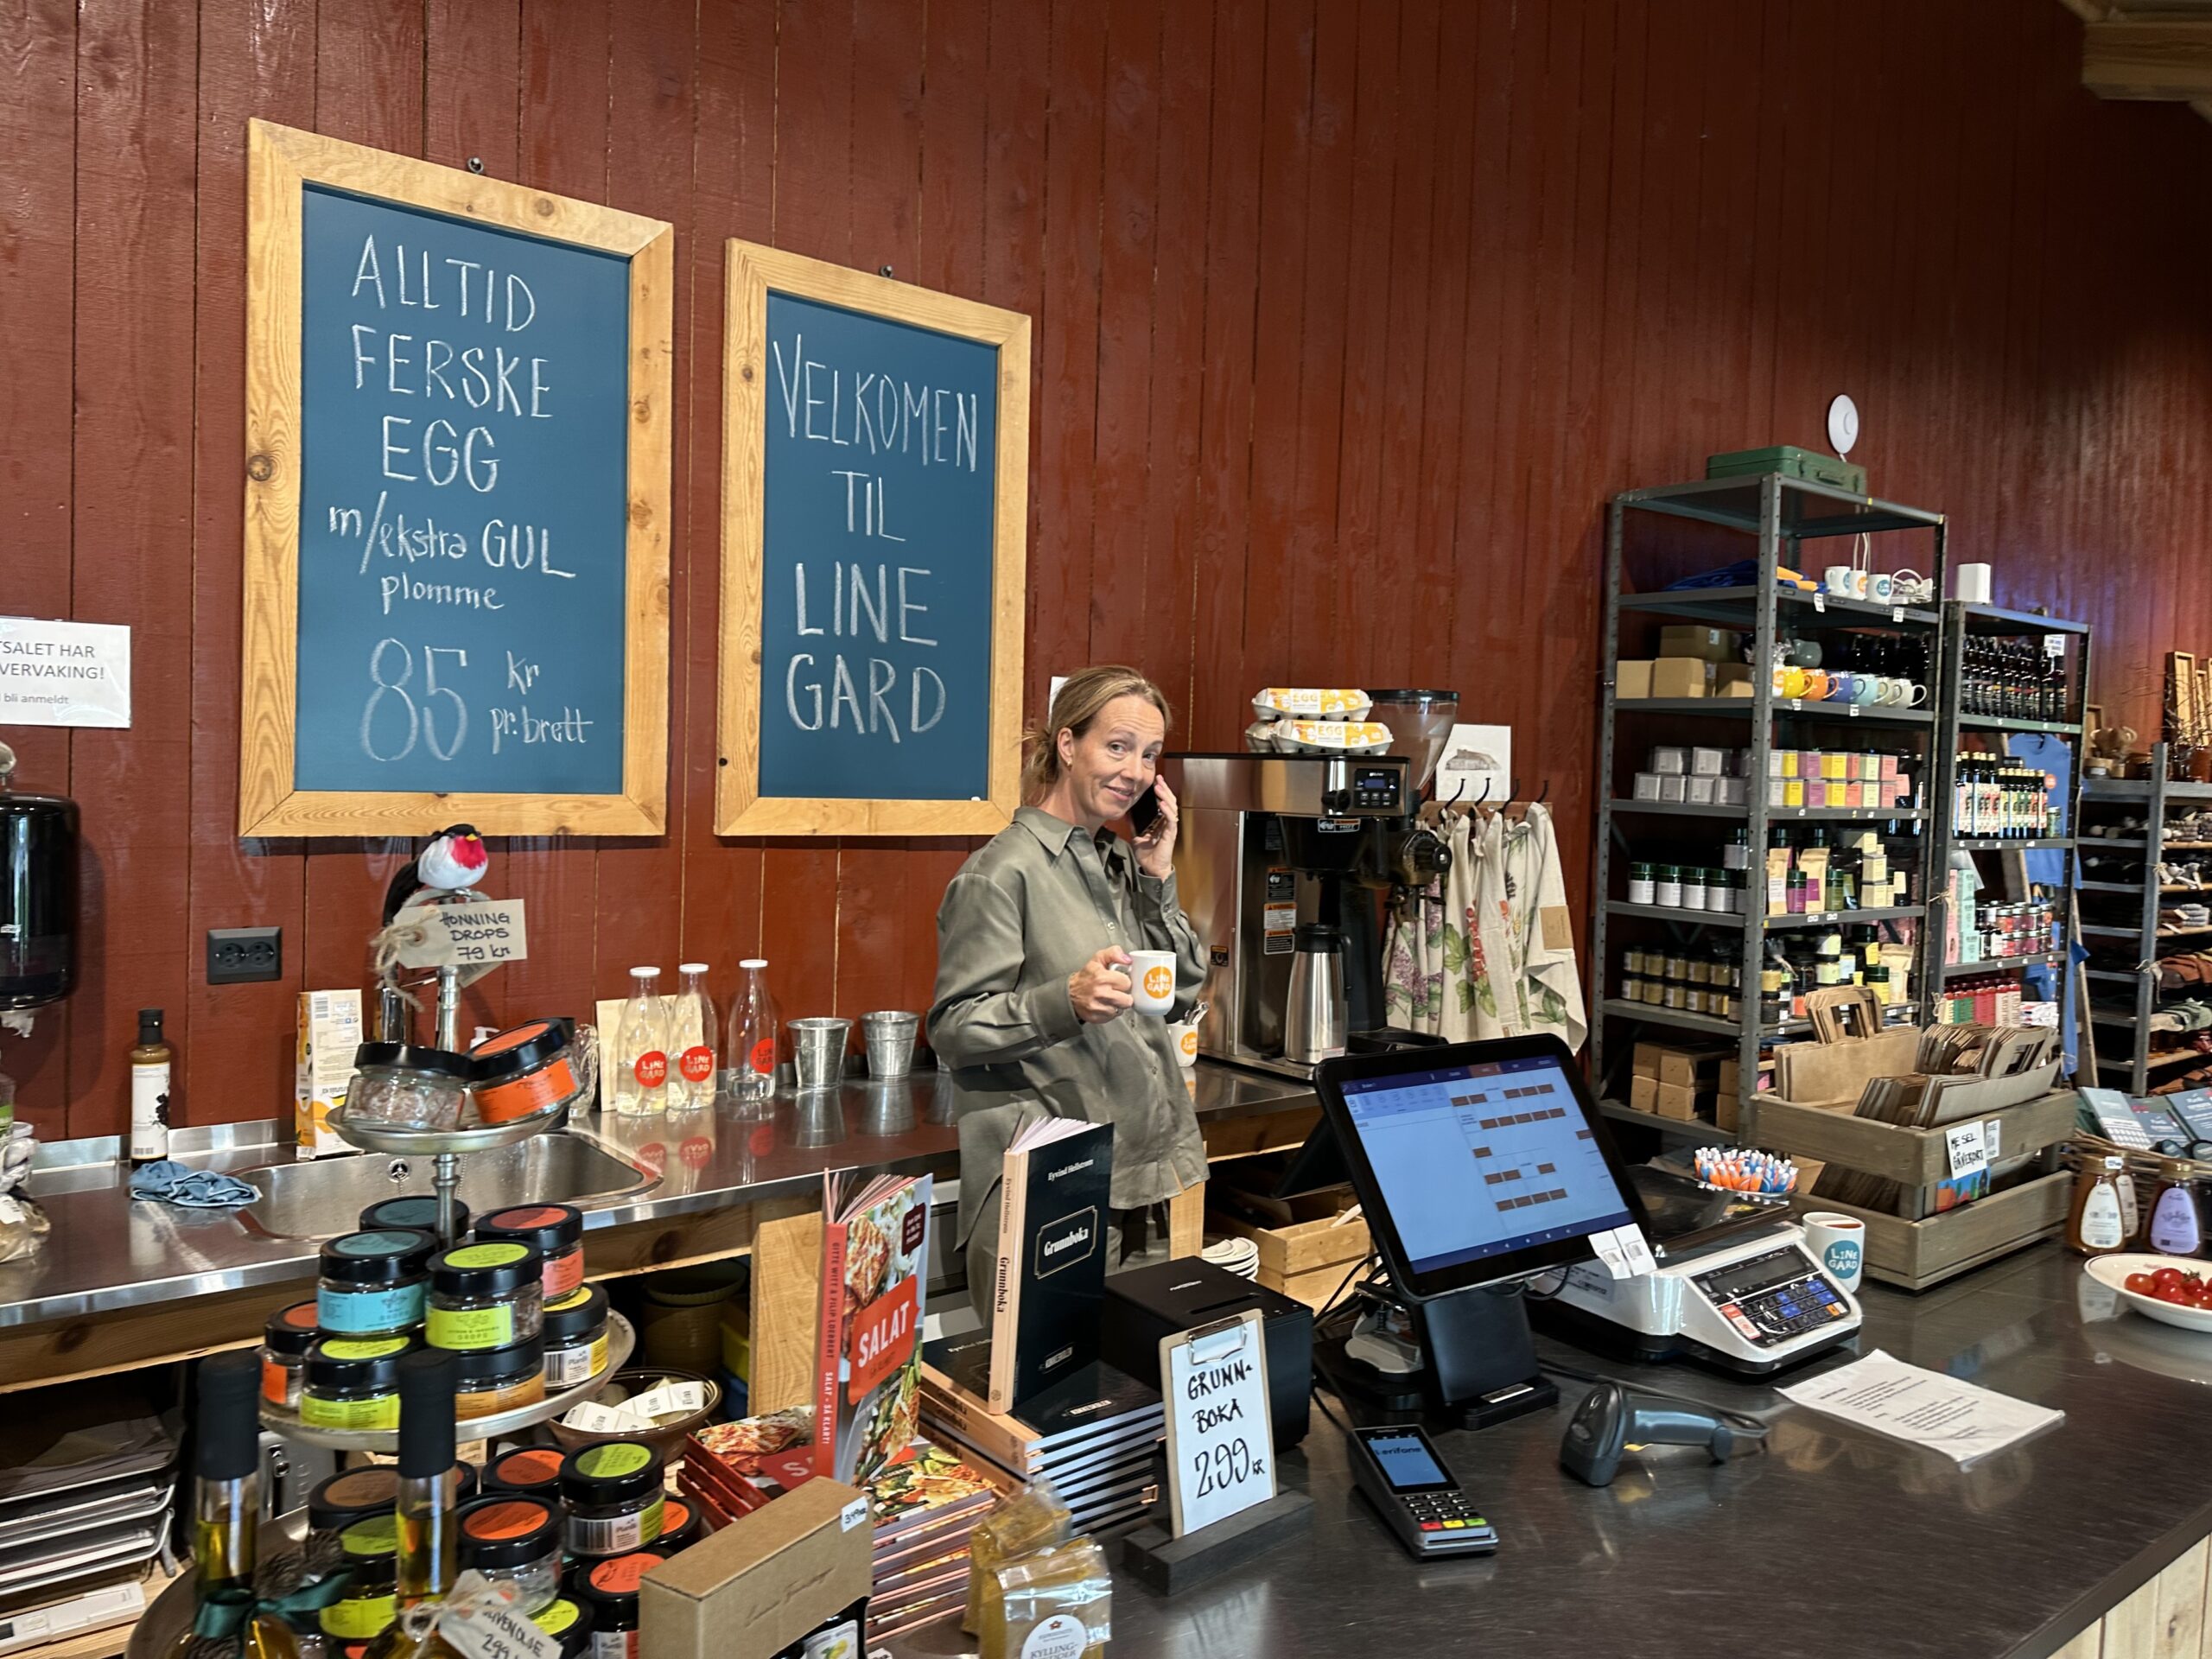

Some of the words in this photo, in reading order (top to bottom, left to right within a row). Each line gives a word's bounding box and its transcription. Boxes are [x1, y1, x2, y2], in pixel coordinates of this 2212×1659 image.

[352, 234, 537, 332] ALLTID
[353, 324, 553, 419] FERSKE
[772, 334, 977, 473] VELKOMEN
[383, 416, 501, 493] EGG
[830, 470, 906, 543] TIL
[329, 491, 467, 575] m/ekstra
[481, 518, 576, 578] GUL
[382, 574, 505, 614] plomme
[795, 561, 938, 646] LINE
[60, 644, 96, 658] HAR
[3, 693, 18, 703] bli
[21, 695, 69, 705] anmeldt
[359, 637, 468, 763] 85
[785, 653, 946, 745] GARD
[1293, 693, 1318, 702] EGG
[1317, 726, 1343, 735] EGG
[439, 912, 511, 928] HONNING
[449, 928, 510, 942] DROPS
[457, 946, 485, 961] 79
[639, 1069, 664, 1079] GARD
[641, 1059, 664, 1070] LINE
[684, 1064, 710, 1074] GARD
[685, 1054, 710, 1065] LINE
[1047, 1166, 1066, 1181] Eyvind
[1044, 1226, 1090, 1256] Grunnboka
[1830, 1248, 1859, 1260] LINE
[1827, 1259, 1858, 1270] GARD
[996, 1256, 1010, 1313] Grunnboka
[858, 1300, 910, 1368] SALAT
[824, 1372, 834, 1395] SALAT
[1187, 1358, 1253, 1401] GRUNN-
[1192, 1398, 1244, 1434] BOKA
[1193, 1437, 1250, 1499] 299
